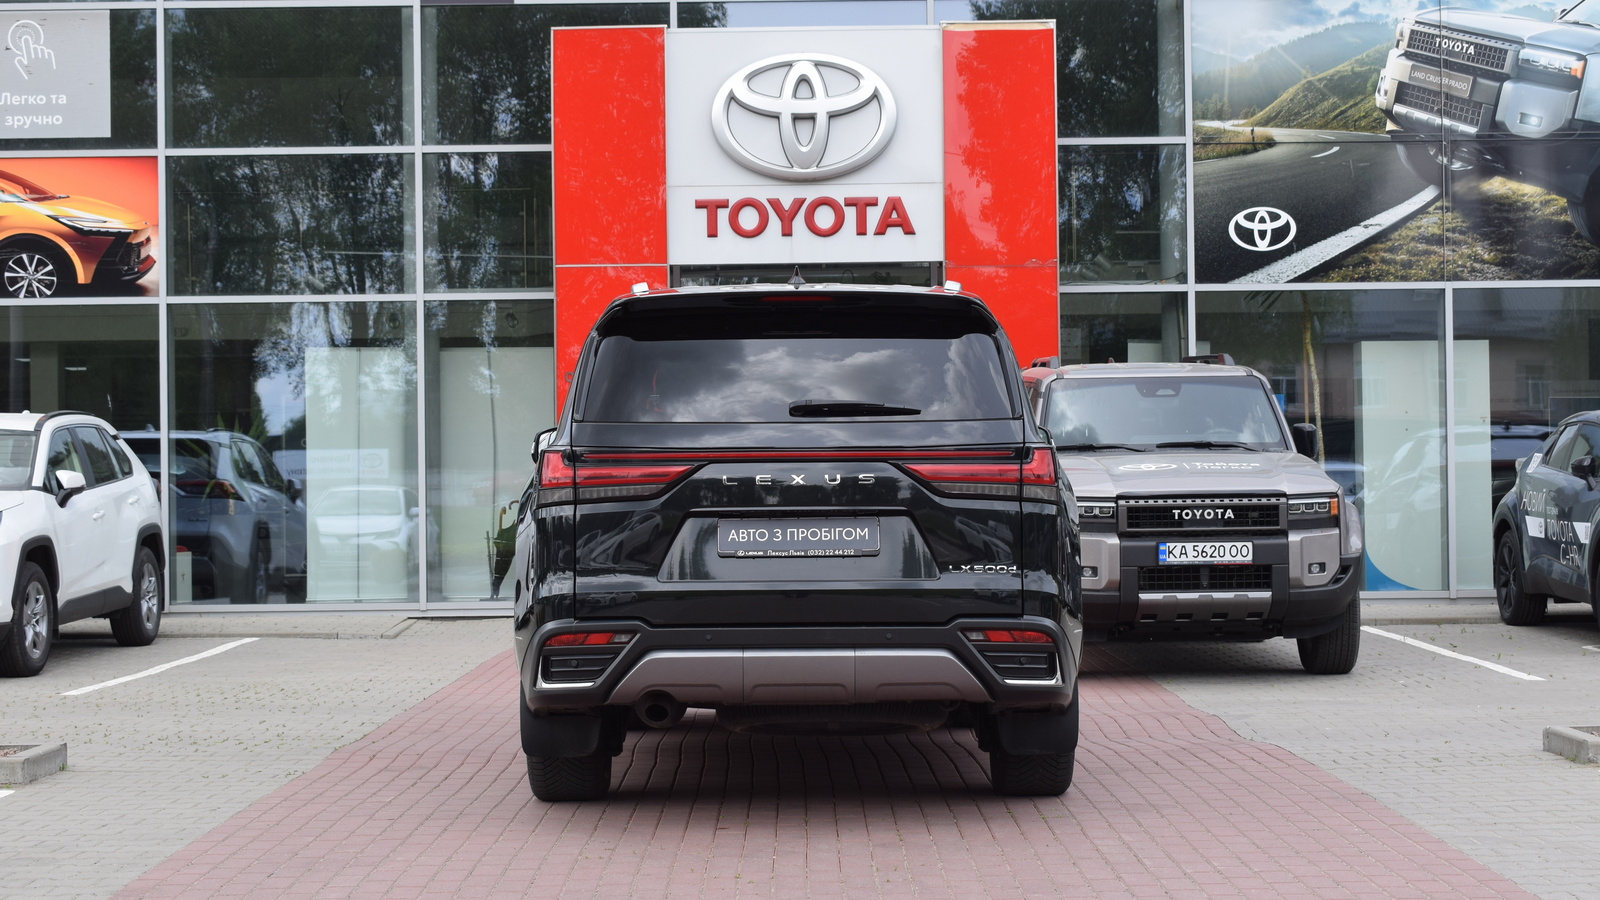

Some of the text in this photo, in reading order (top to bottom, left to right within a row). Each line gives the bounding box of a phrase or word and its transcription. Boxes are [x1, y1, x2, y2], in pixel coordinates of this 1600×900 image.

[1435, 37, 1475, 55] TOYOTA
[1411, 69, 1425, 80] LAND
[1448, 78, 1468, 91] PRADO
[0, 92, 67, 105] Легко та
[5, 115, 63, 128] зручно
[695, 196, 916, 238] TOYOTA
[722, 473, 876, 486] LEXUS
[1520, 488, 1547, 513] НОВИЙ
[1172, 508, 1235, 520] TOYOTA
[728, 529, 769, 542] АВТО
[787, 527, 870, 541] ПРОБІГОМ
[1547, 519, 1575, 543] TOYOTA
[1167, 545, 1189, 559] KA
[1192, 544, 1226, 559] 5620
[1560, 543, 1581, 567] C-HR
